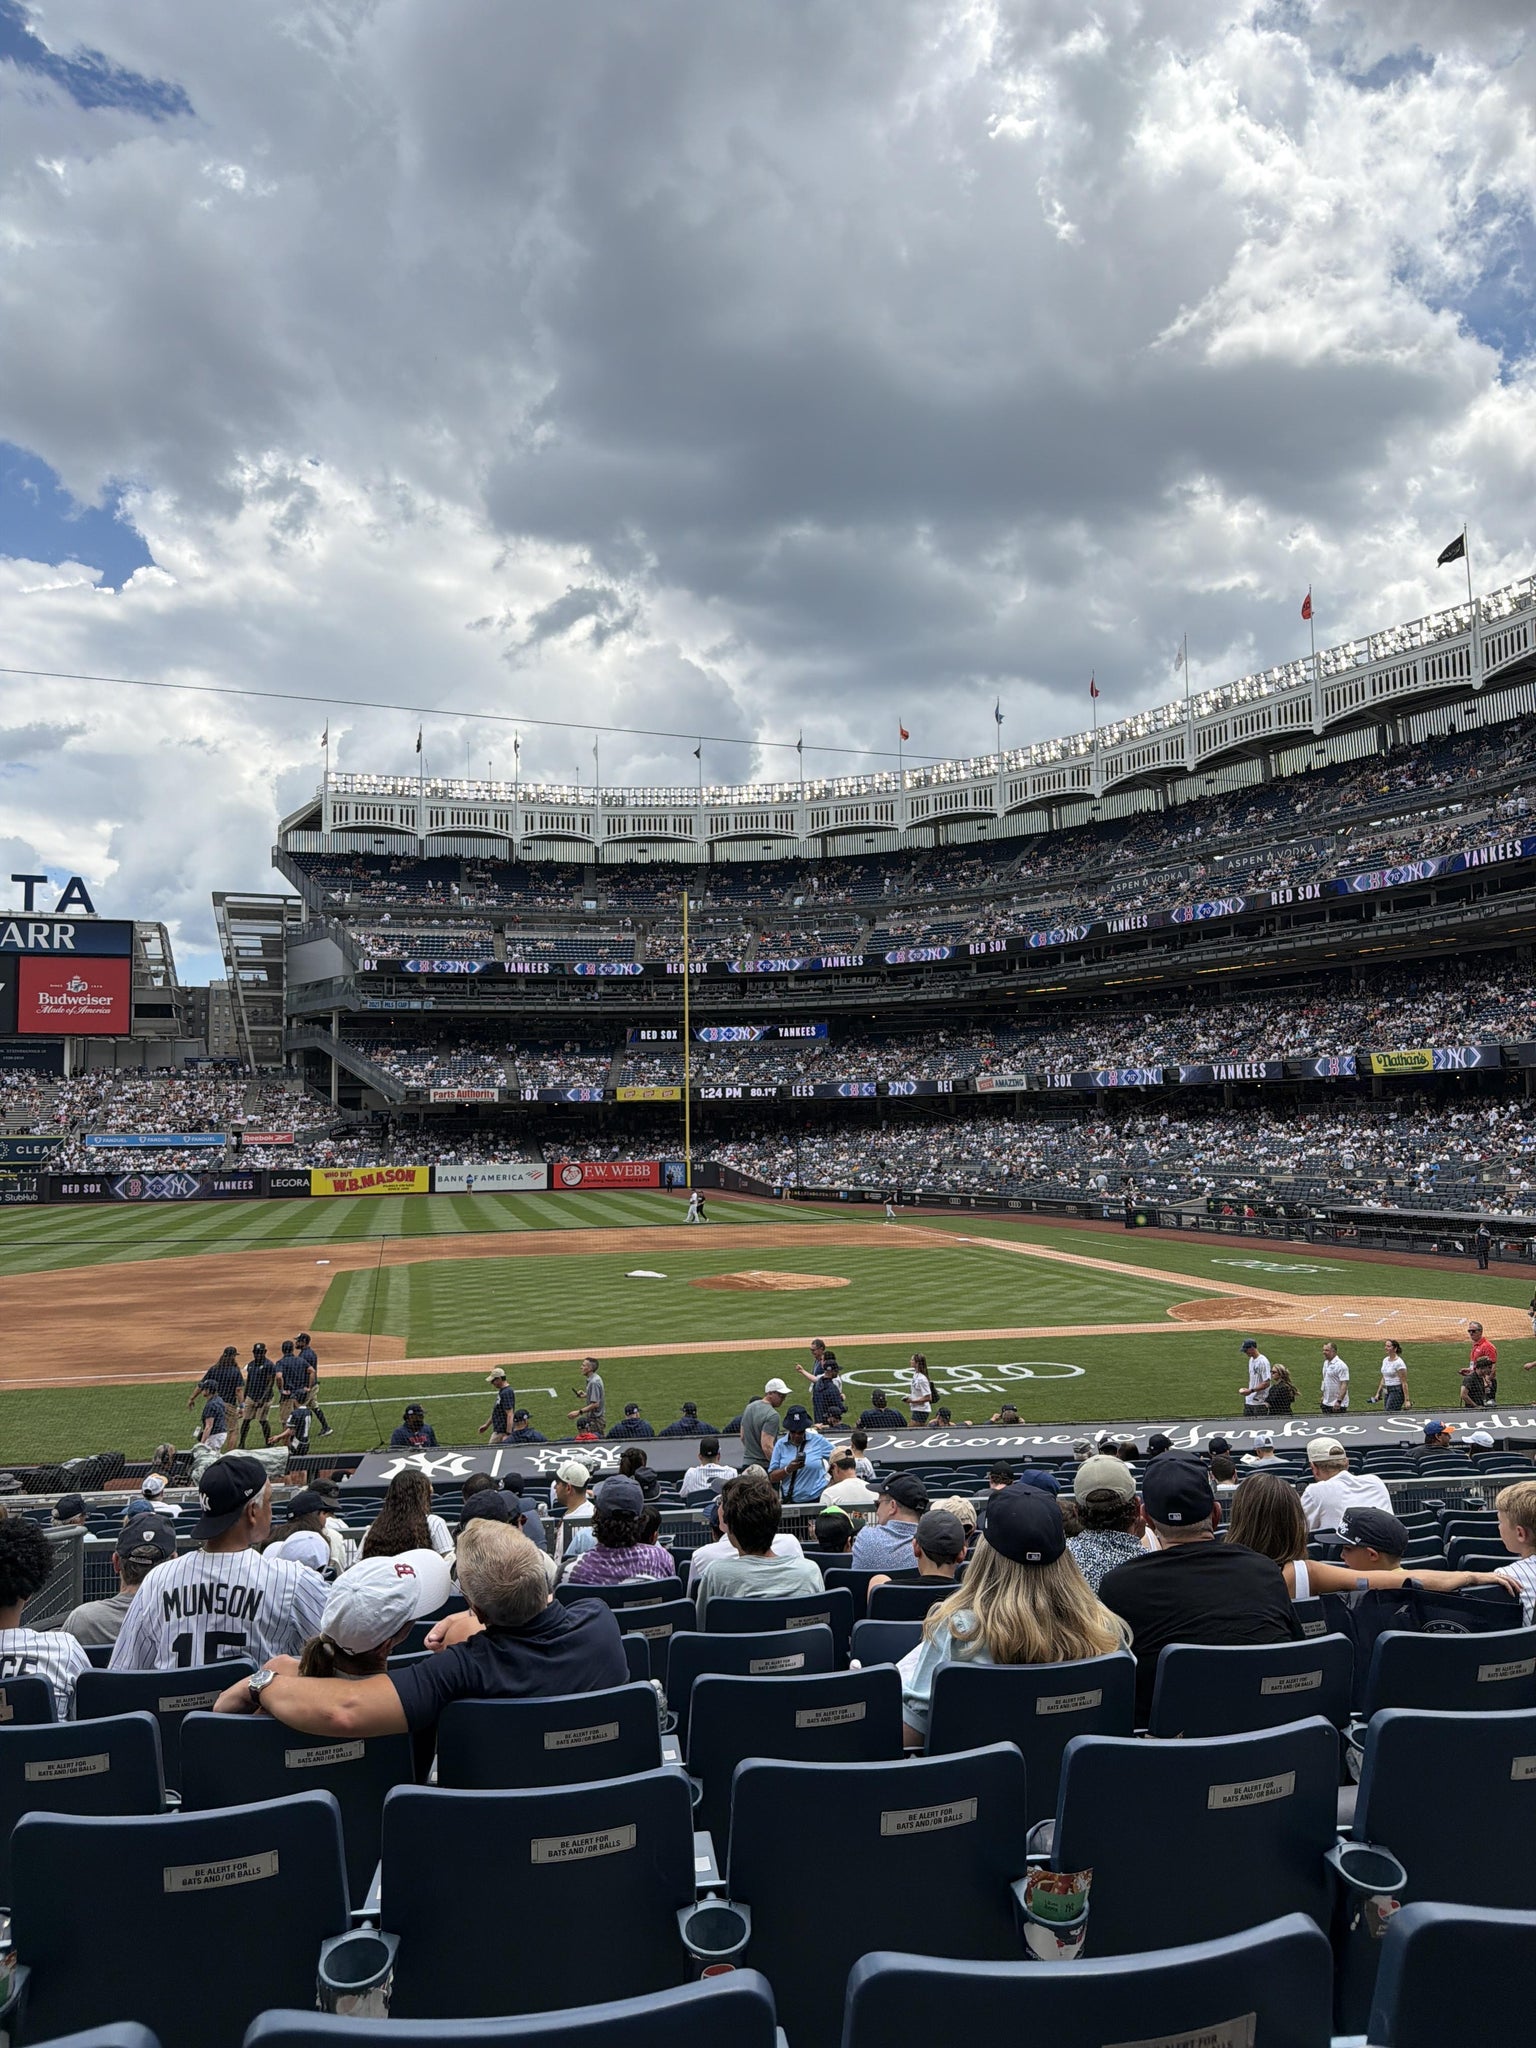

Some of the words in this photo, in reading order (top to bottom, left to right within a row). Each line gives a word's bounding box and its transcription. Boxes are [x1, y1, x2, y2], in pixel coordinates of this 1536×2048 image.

[1463, 840, 1522, 868] YANKEES
[1228, 854, 1264, 869] ASPEN
[1110, 880, 1140, 893] ASPEN
[1151, 871, 1184, 884] VODKA
[1271, 888, 1292, 905] RED
[1298, 884, 1321, 901] SOX
[1107, 915, 1148, 933] YANKEES
[0, 921, 76, 949] ARR
[969, 943, 986, 955] RED
[989, 940, 1007, 952] SOX
[504, 962, 550, 973] YANKEES
[821, 955, 864, 968] YANKEES
[667, 963, 685, 974] RED
[689, 963, 708, 973] SOX
[38, 992, 114, 1005] Budweiser
[36, 1005, 65, 1014] Made
[74, 1005, 111, 1014] America
[640, 1030, 658, 1040] RED
[660, 1030, 678, 1040] SOX
[778, 1026, 816, 1038] YANKEES
[1376, 1052, 1428, 1067] Nathan's
[1212, 1063, 1266, 1080] YANKEES
[995, 1078, 1024, 1087] AMAZING
[1054, 1074, 1072, 1087] SOX
[433, 1090, 456, 1099] Parts
[456, 1089, 495, 1099] Authority
[700, 1087, 723, 1099] 1:24
[725, 1087, 742, 1098] PM
[750, 1088, 777, 1097] 80.1°F
[243, 1134, 273, 1142] Reebok
[324, 1171, 338, 1179] WHO
[584, 1165, 608, 1177] F.W.
[611, 1165, 651, 1177] WEBB
[213, 1180, 253, 1191] YANKEES
[271, 1178, 310, 1188] LEGORA
[437, 1175, 464, 1183] BANK
[62, 1184, 80, 1194] RED
[83, 1183, 101, 1194] SOX
[4, 1193, 38, 1201] StubHub
[1137, 1420, 1366, 1449] Yankee
[538, 1446, 622, 1458] NEW
[163, 1582, 264, 1622] MUNSON
[172, 1631, 247, 1668] 15
[336, 1751, 353, 1759] BALLS
[1242, 1785, 1258, 1793] ALERT
[1258, 1781, 1274, 1789] FOR
[1239, 1791, 1265, 1802] AND/OR
[1265, 1787, 1282, 1796] BALLS
[919, 1811, 940, 1820] ALERT
[940, 1808, 953, 1816] FOR
[915, 1817, 942, 1829] AND/OR
[943, 1813, 963, 1823] BALLS
[560, 1841, 571, 1849] BE
[572, 1837, 594, 1847] ALERT
[595, 1834, 609, 1843] FOR
[547, 1849, 567, 1858] BATS
[568, 1844, 598, 1856] AND/OR
[599, 1839, 621, 1850] BALLS
[195, 1868, 205, 1877] BE
[207, 1865, 231, 1876] ALERT
[233, 1862, 248, 1871] FOR
[182, 1878, 202, 1886] BATS
[203, 1872, 237, 1885] AND/OR
[237, 1867, 261, 1878] BALLS
[1198, 2033, 1218, 2047] FOR
